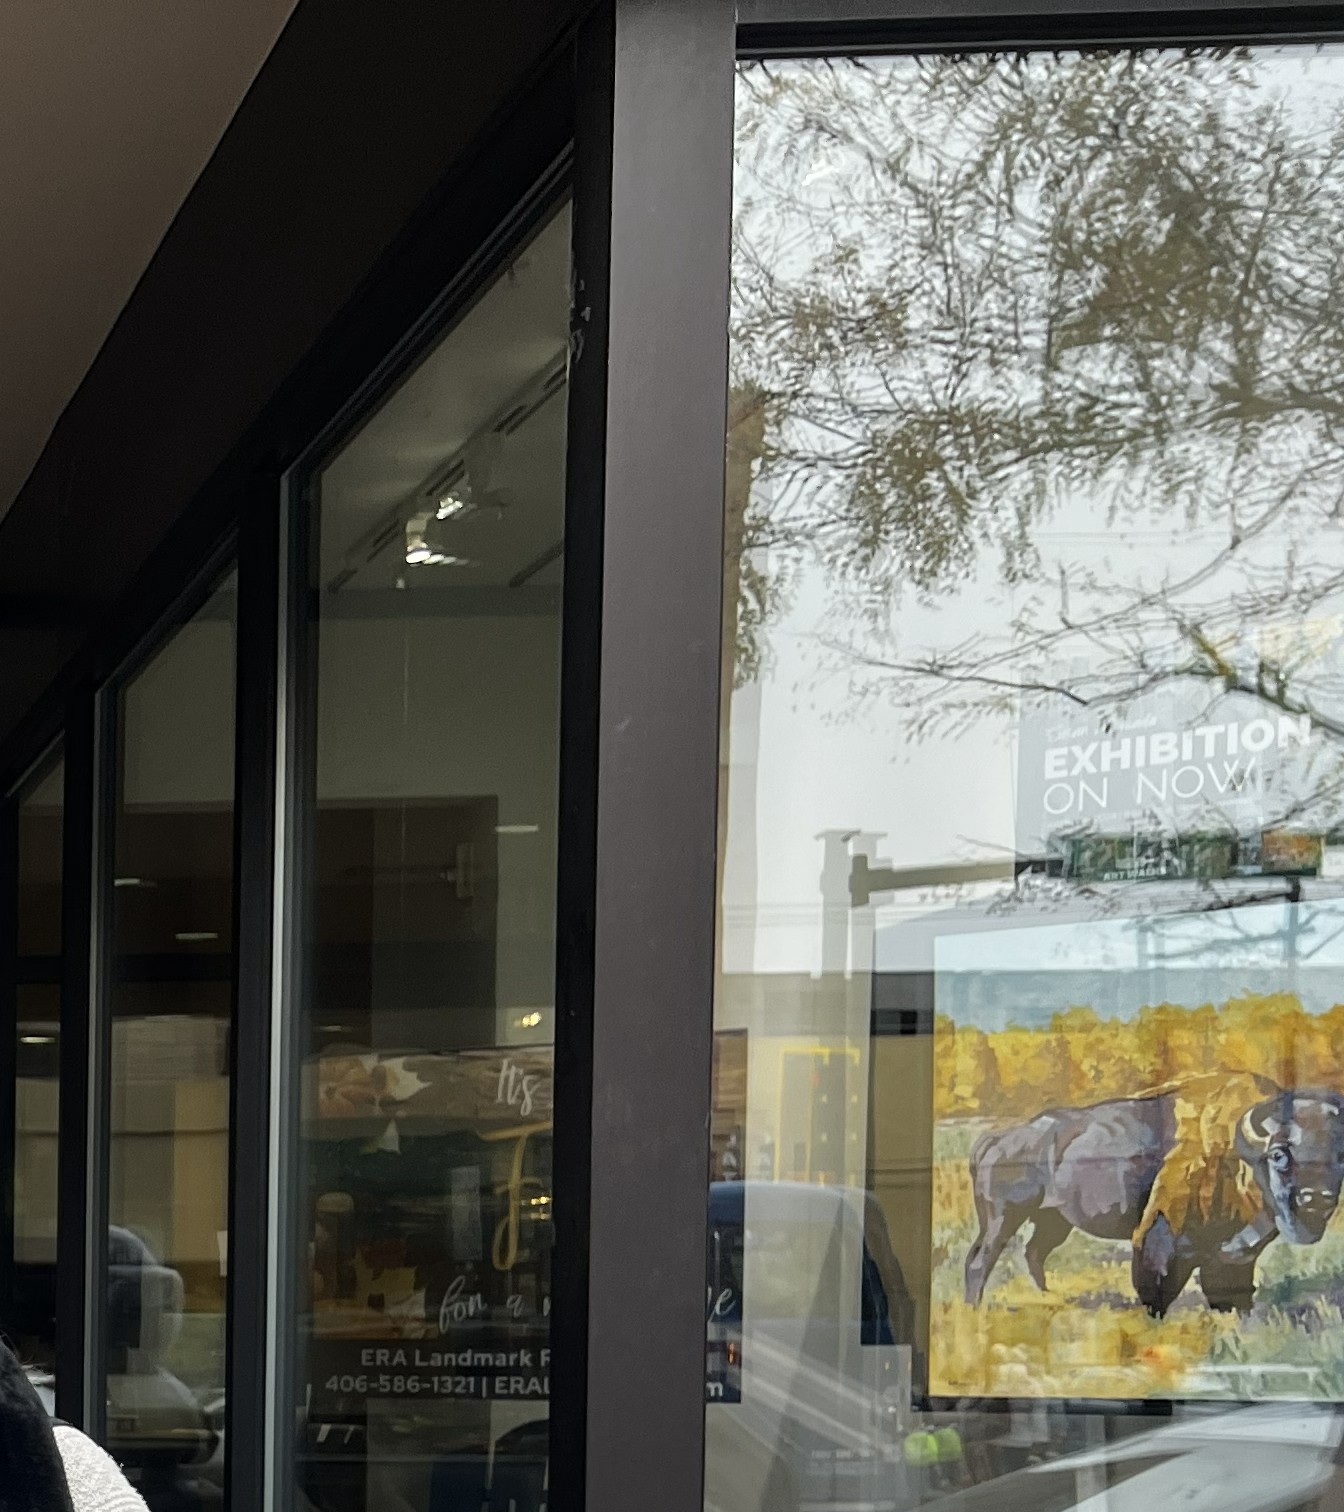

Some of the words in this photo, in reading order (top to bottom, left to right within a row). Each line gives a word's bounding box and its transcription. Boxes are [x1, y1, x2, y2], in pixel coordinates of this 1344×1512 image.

[1044, 715, 1311, 780] EXHIBITION
[1043, 776, 1107, 815] ON
[1136, 757, 1256, 803] NOW
[361, 1348, 408, 1367] ERA
[414, 1348, 532, 1368] Landmark
[325, 1373, 475, 1394] 406-586-1321
